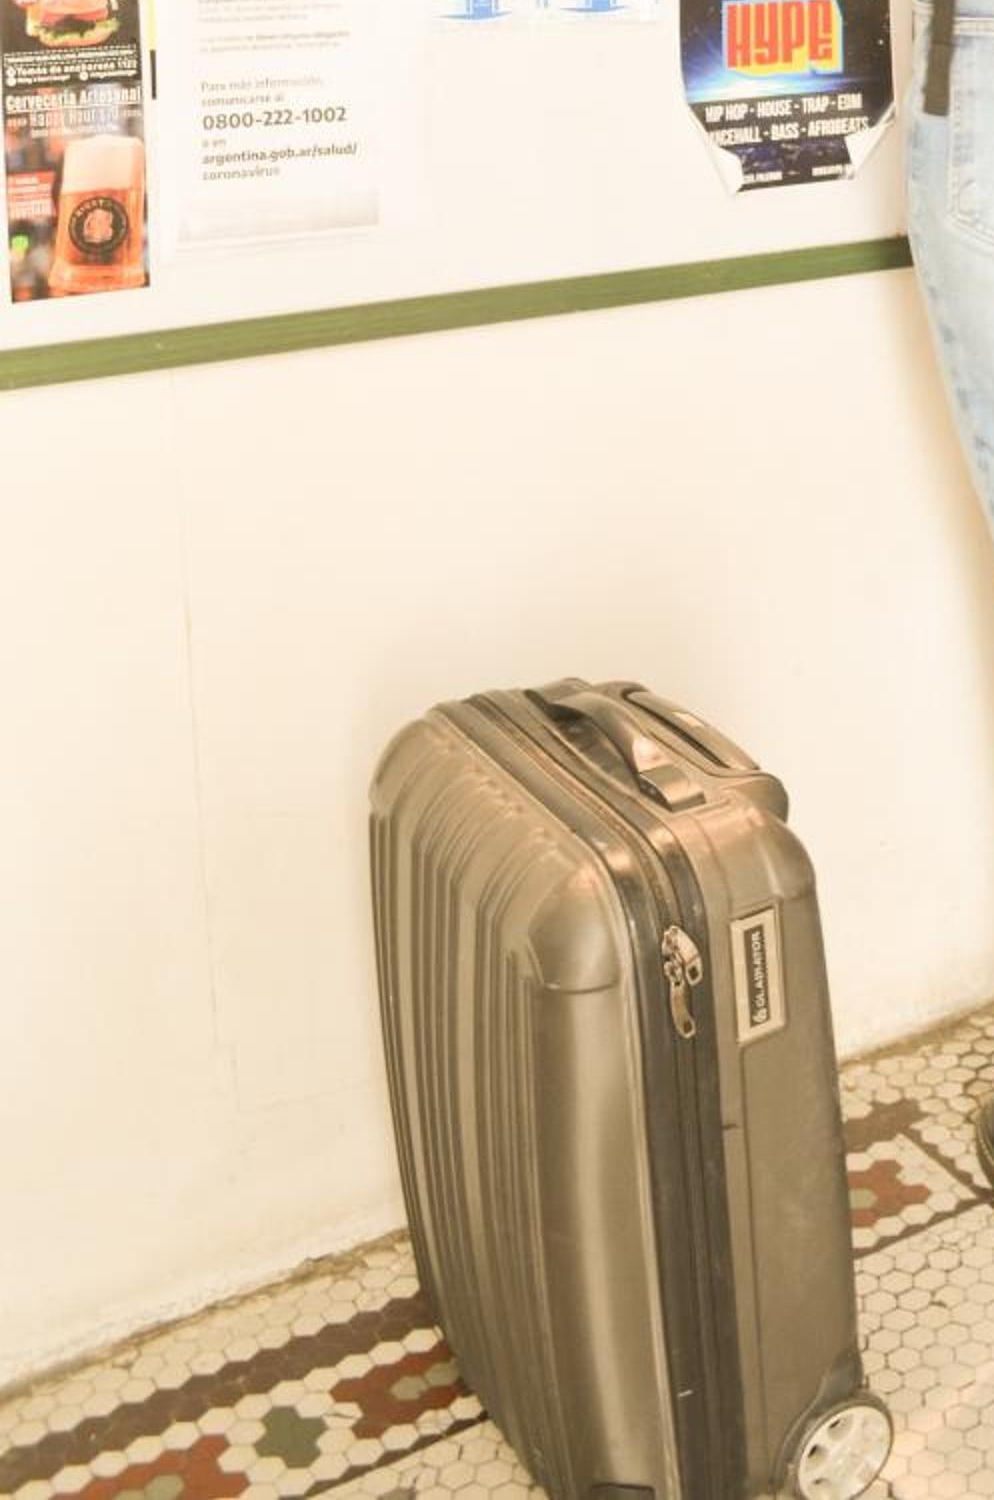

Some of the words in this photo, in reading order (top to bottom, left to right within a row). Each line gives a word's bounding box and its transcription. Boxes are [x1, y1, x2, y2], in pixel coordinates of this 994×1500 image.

[202, 106, 349, 131] 0800-222-1002
[726, 103, 749, 121] HOP
[757, 99, 793, 118] HOUSE
[800, 95, 830, 114] TRAP
[770, 123, 800, 140] BASS
[807, 116, 869, 137] AFROBEATS
[202, 141, 358, 165] argentina.gob.ar/salud/
